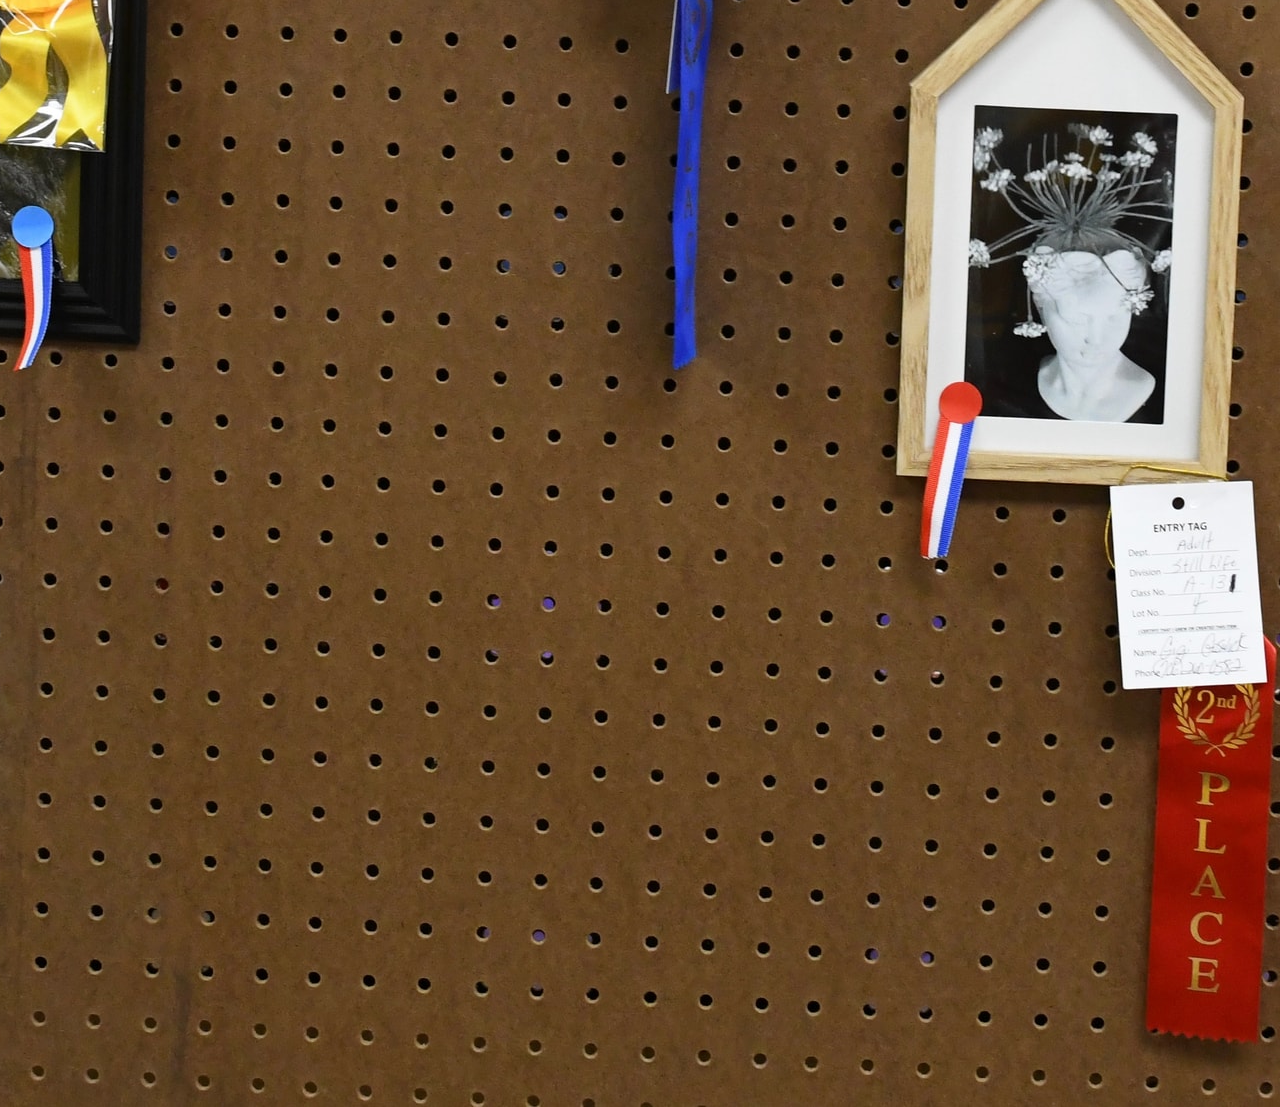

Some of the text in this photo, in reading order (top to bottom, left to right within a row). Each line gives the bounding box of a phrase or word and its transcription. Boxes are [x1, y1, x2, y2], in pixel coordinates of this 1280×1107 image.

[1153, 521, 1208, 533] ENTRY TAG
[1195, 689, 1237, 725] 2nd
[1187, 771, 1231, 993] PLACE
